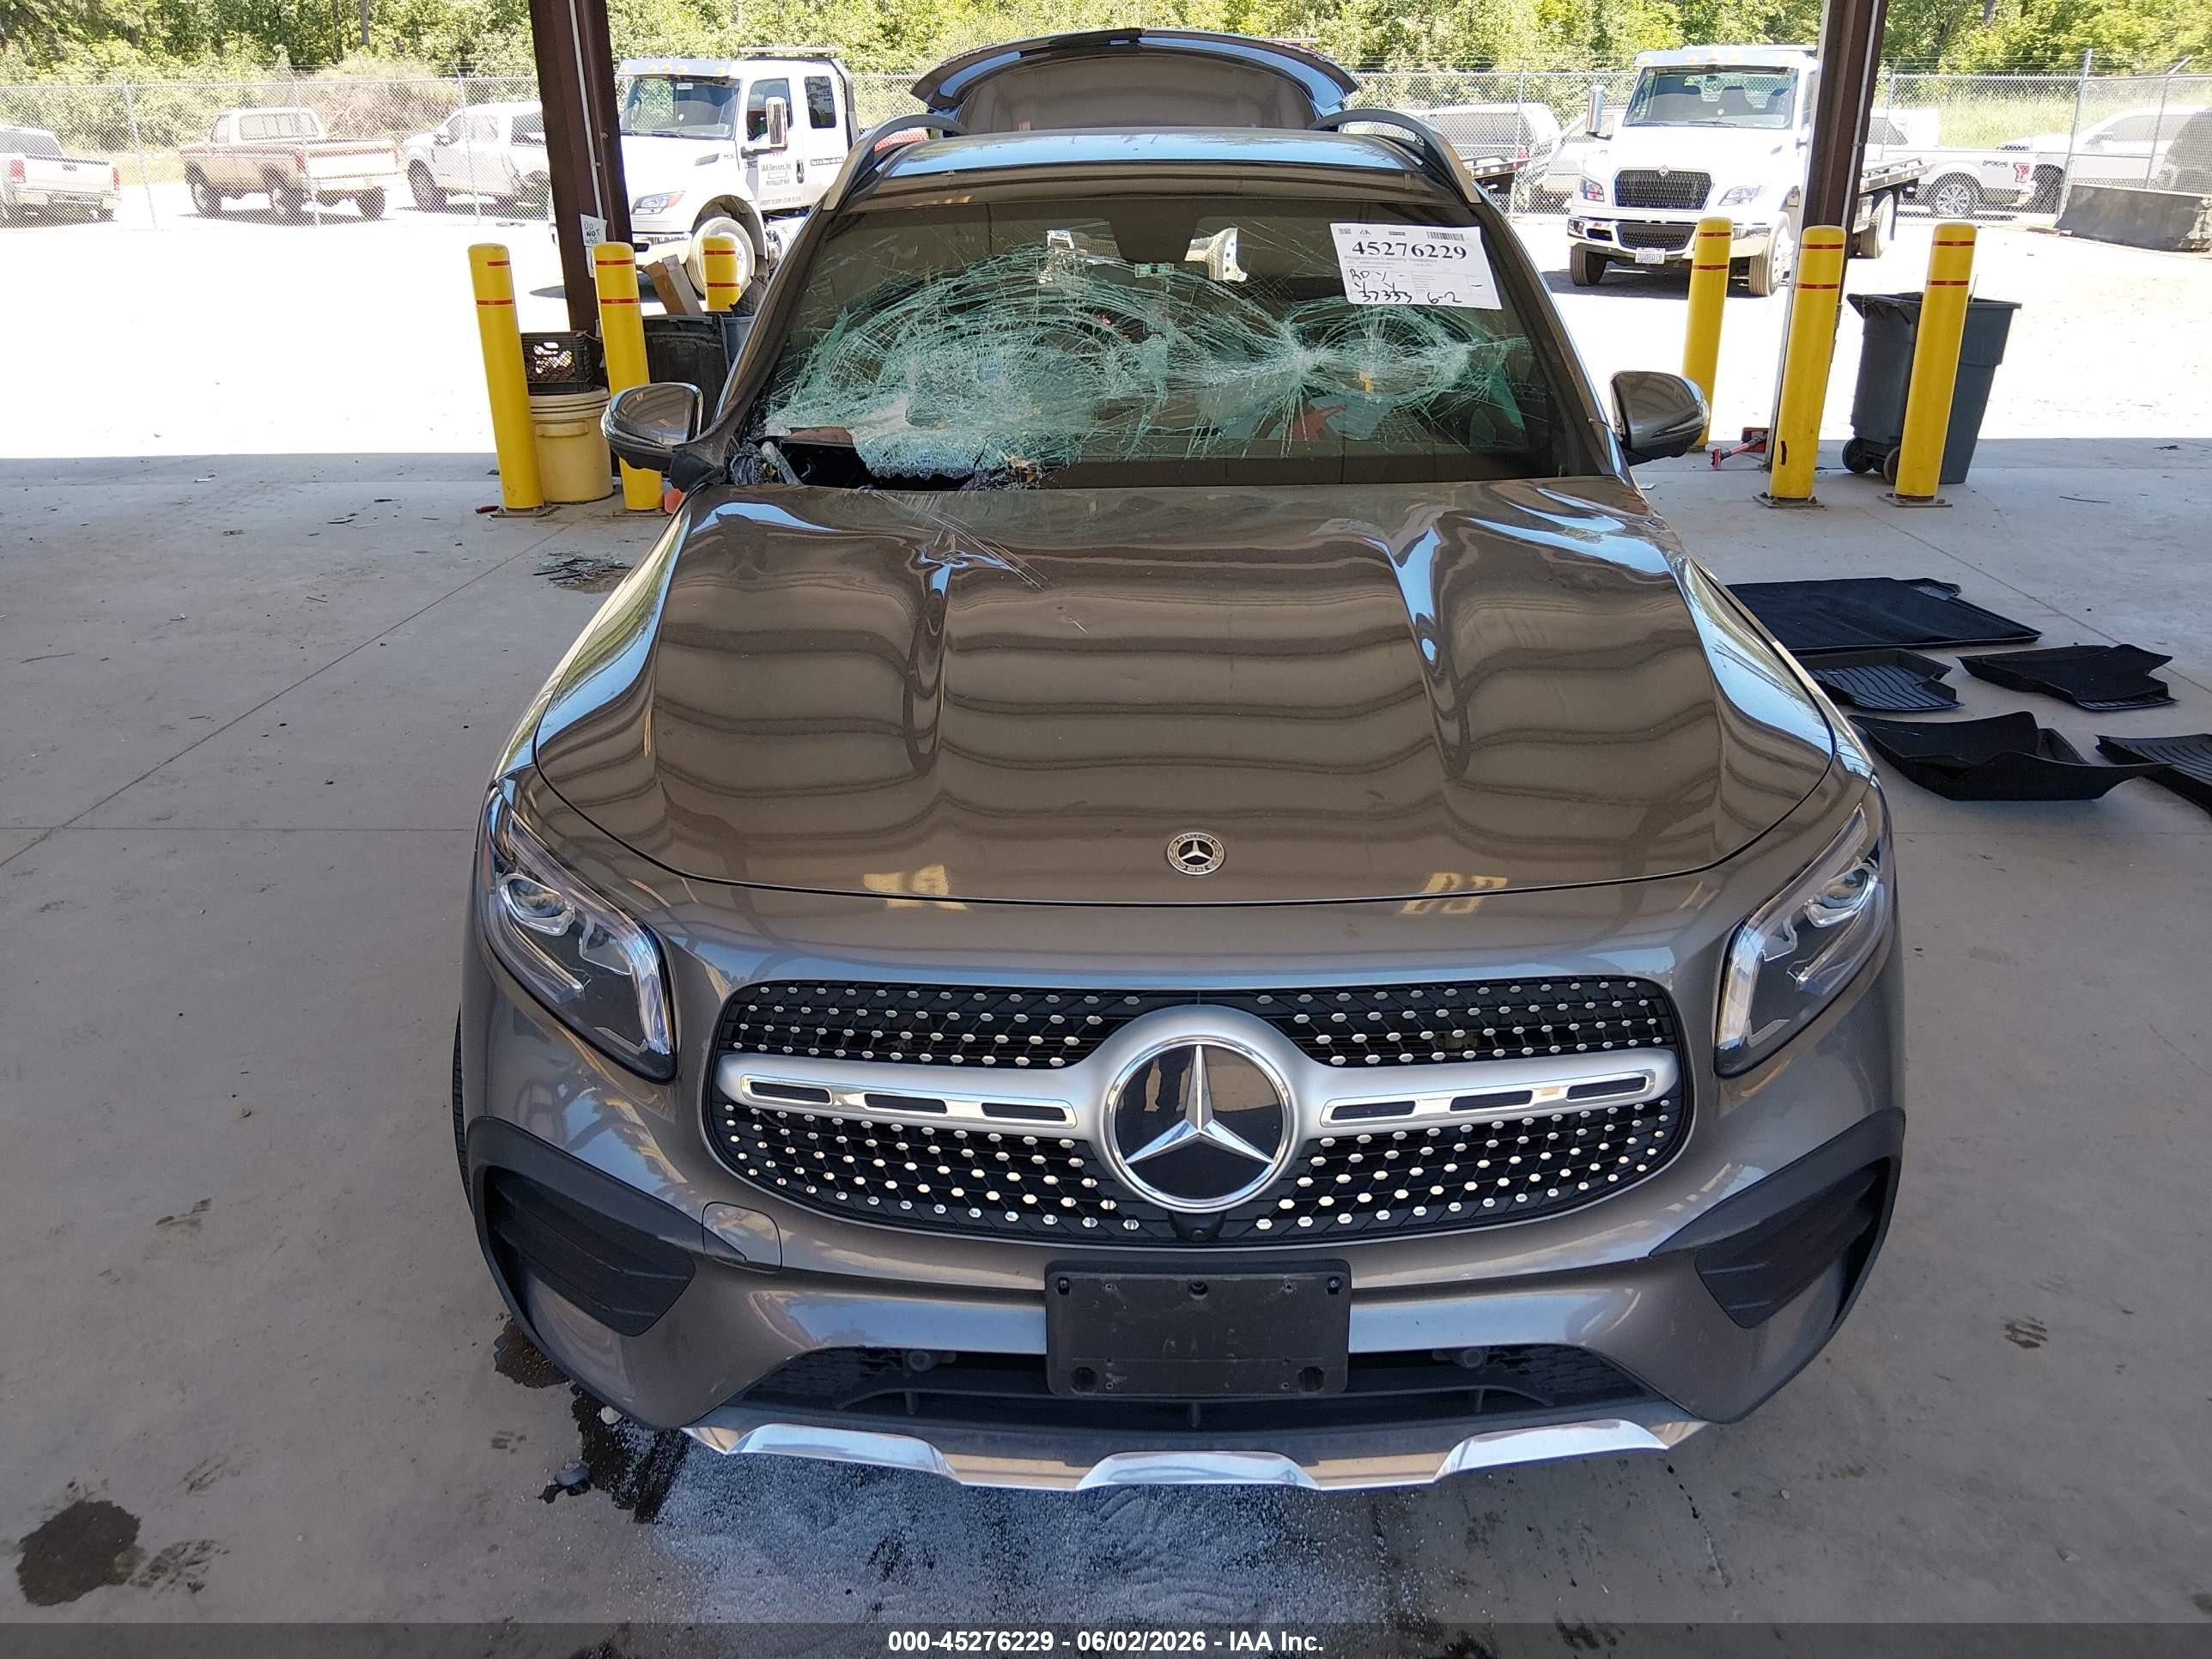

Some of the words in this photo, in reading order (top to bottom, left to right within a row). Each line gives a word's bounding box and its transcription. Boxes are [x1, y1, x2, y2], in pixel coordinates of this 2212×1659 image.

[584, 220, 593, 230] DO
[586, 228, 600, 237] NOT
[1352, 240, 1467, 259] 45276229
[1426, 291, 1462, 304] 6-2
